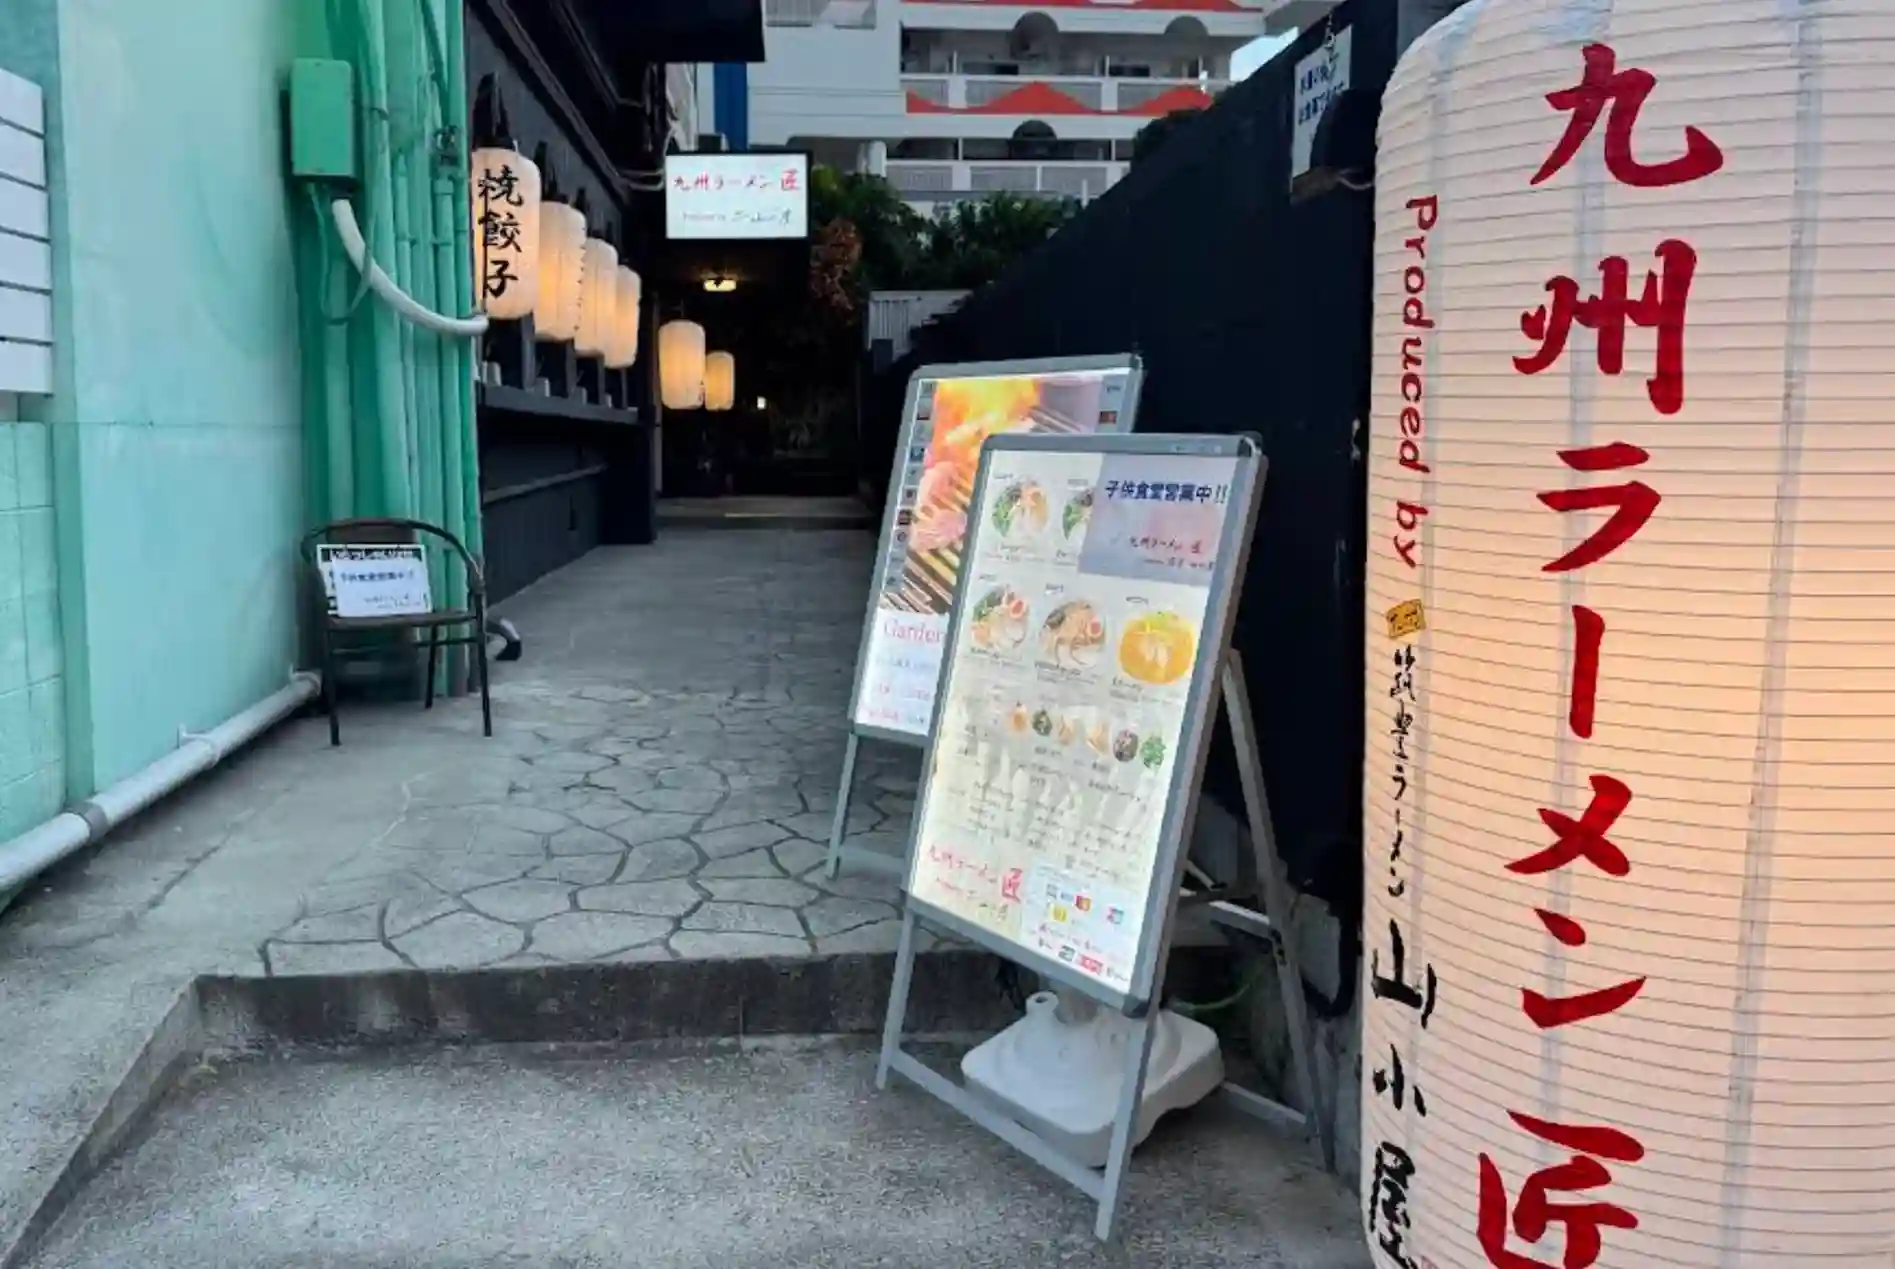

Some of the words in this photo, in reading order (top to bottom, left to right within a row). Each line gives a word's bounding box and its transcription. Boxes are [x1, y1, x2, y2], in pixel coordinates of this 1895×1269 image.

[477, 163, 525, 299] 焼餃子
[1399, 194, 1438, 474] Produced
[1394, 499, 1429, 568] by
